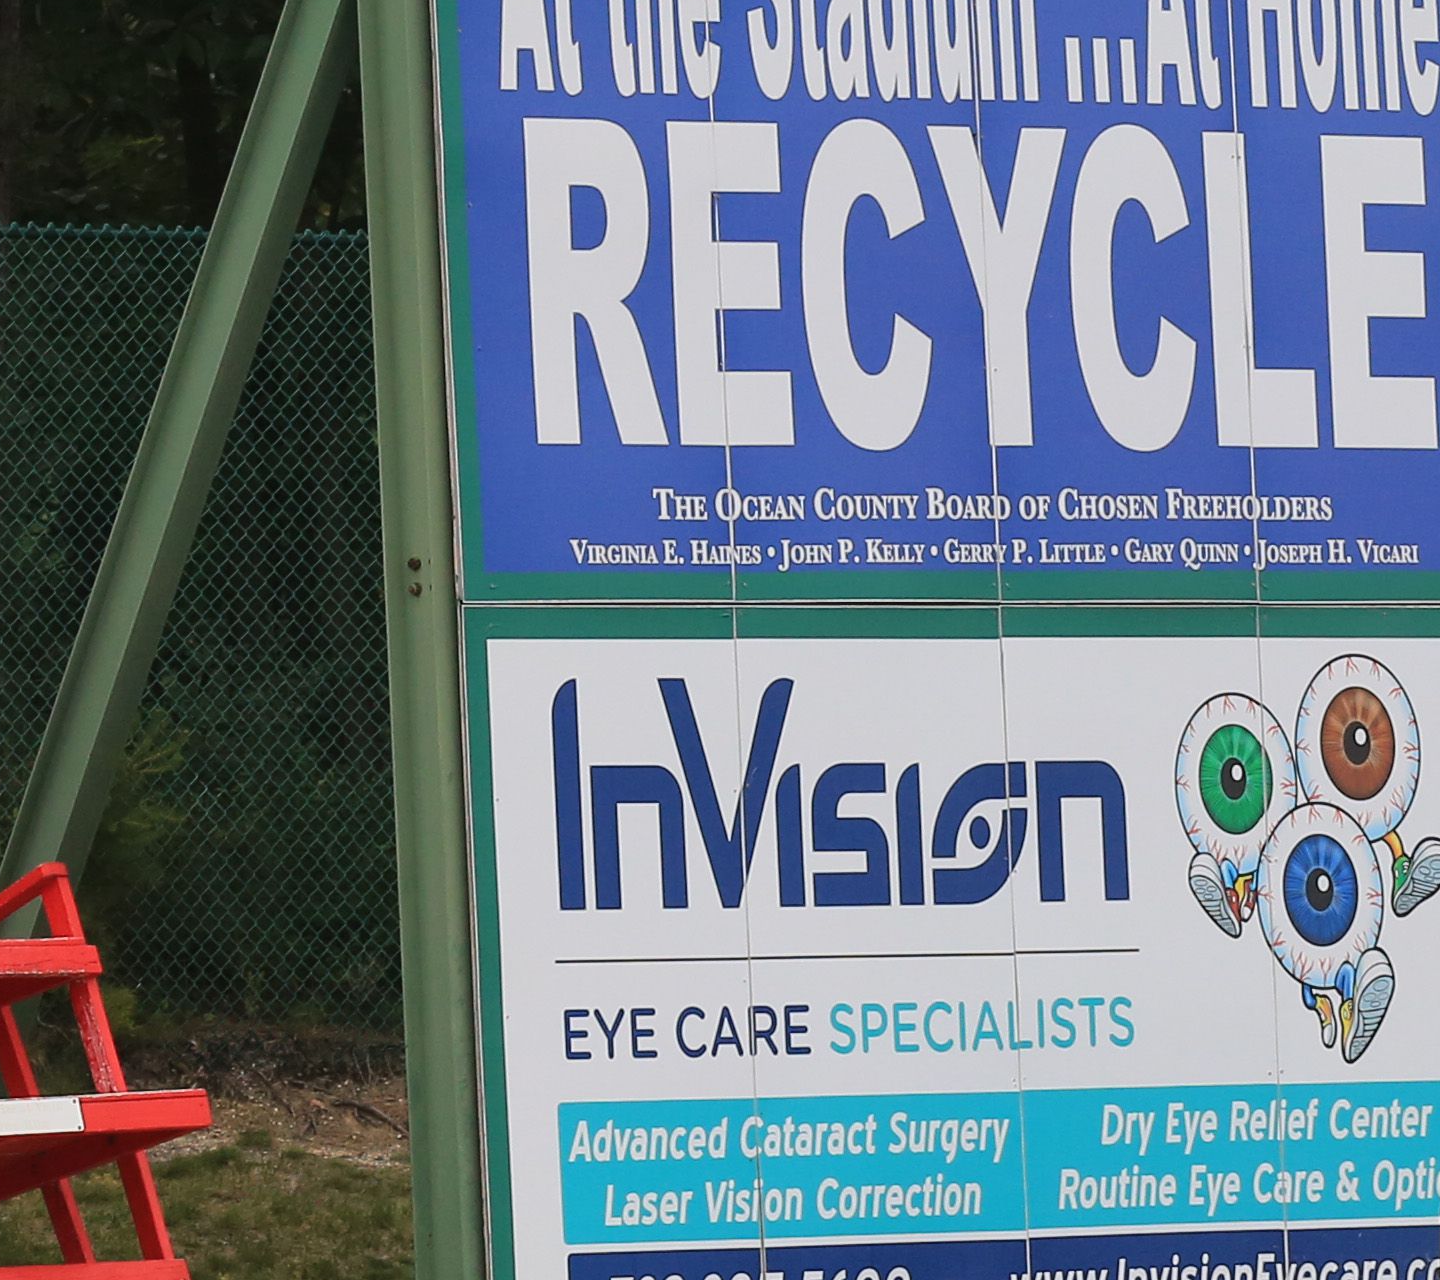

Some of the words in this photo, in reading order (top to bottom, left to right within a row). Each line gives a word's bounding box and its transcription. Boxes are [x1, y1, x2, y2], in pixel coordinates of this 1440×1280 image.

[521, 116, 1440, 453] RECYCLE
[652, 487, 708, 521] THE
[715, 487, 806, 522] OCEAN
[813, 487, 919, 522] COUNTY
[925, 487, 1011, 521] BOARD
[1018, 495, 1051, 521] OF
[1058, 487, 1159, 522] CHOSEN
[1165, 487, 1334, 522] FREEHOLDERS
[569, 538, 658, 565] VIRGINIA
[662, 538, 685, 565] E.
[689, 538, 762, 565] HAINES
[777, 538, 833, 573] JOHN
[838, 538, 860, 564] P.
[865, 538, 926, 564] KELLY
[943, 538, 1007, 565] GERRY
[1012, 538, 1034, 564] P.
[1039, 538, 1106, 564] LITTLE
[1124, 538, 1174, 564] GARY
[1179, 538, 1239, 571] QUINN
[1253, 538, 1322, 571] JOSEPH
[1327, 538, 1352, 564] H.
[1356, 538, 1419, 564] VICARI
[564, 1007, 658, 1062] EYE
[675, 1002, 813, 1058] CARE
[827, 995, 1137, 1055] SPECIALISTS
[567, 1116, 727, 1165] Advanced
[739, 1113, 878, 1157] Cataract
[887, 1110, 1010, 1164] Surgery
[1099, 1105, 1155, 1150] Dry
[1164, 1103, 1220, 1150] Eye
[1228, 1099, 1319, 1142] Relief
[1328, 1097, 1433, 1140] Center
[602, 1184, 696, 1227] Laser
[702, 1179, 803, 1223] Vision
[809, 1174, 982, 1220] Correction
[1057, 1164, 1178, 1212] Routine
[1185, 1164, 1241, 1215] Eye
[1248, 1163, 1325, 1206] Care
[1336, 1160, 1361, 1202] &
